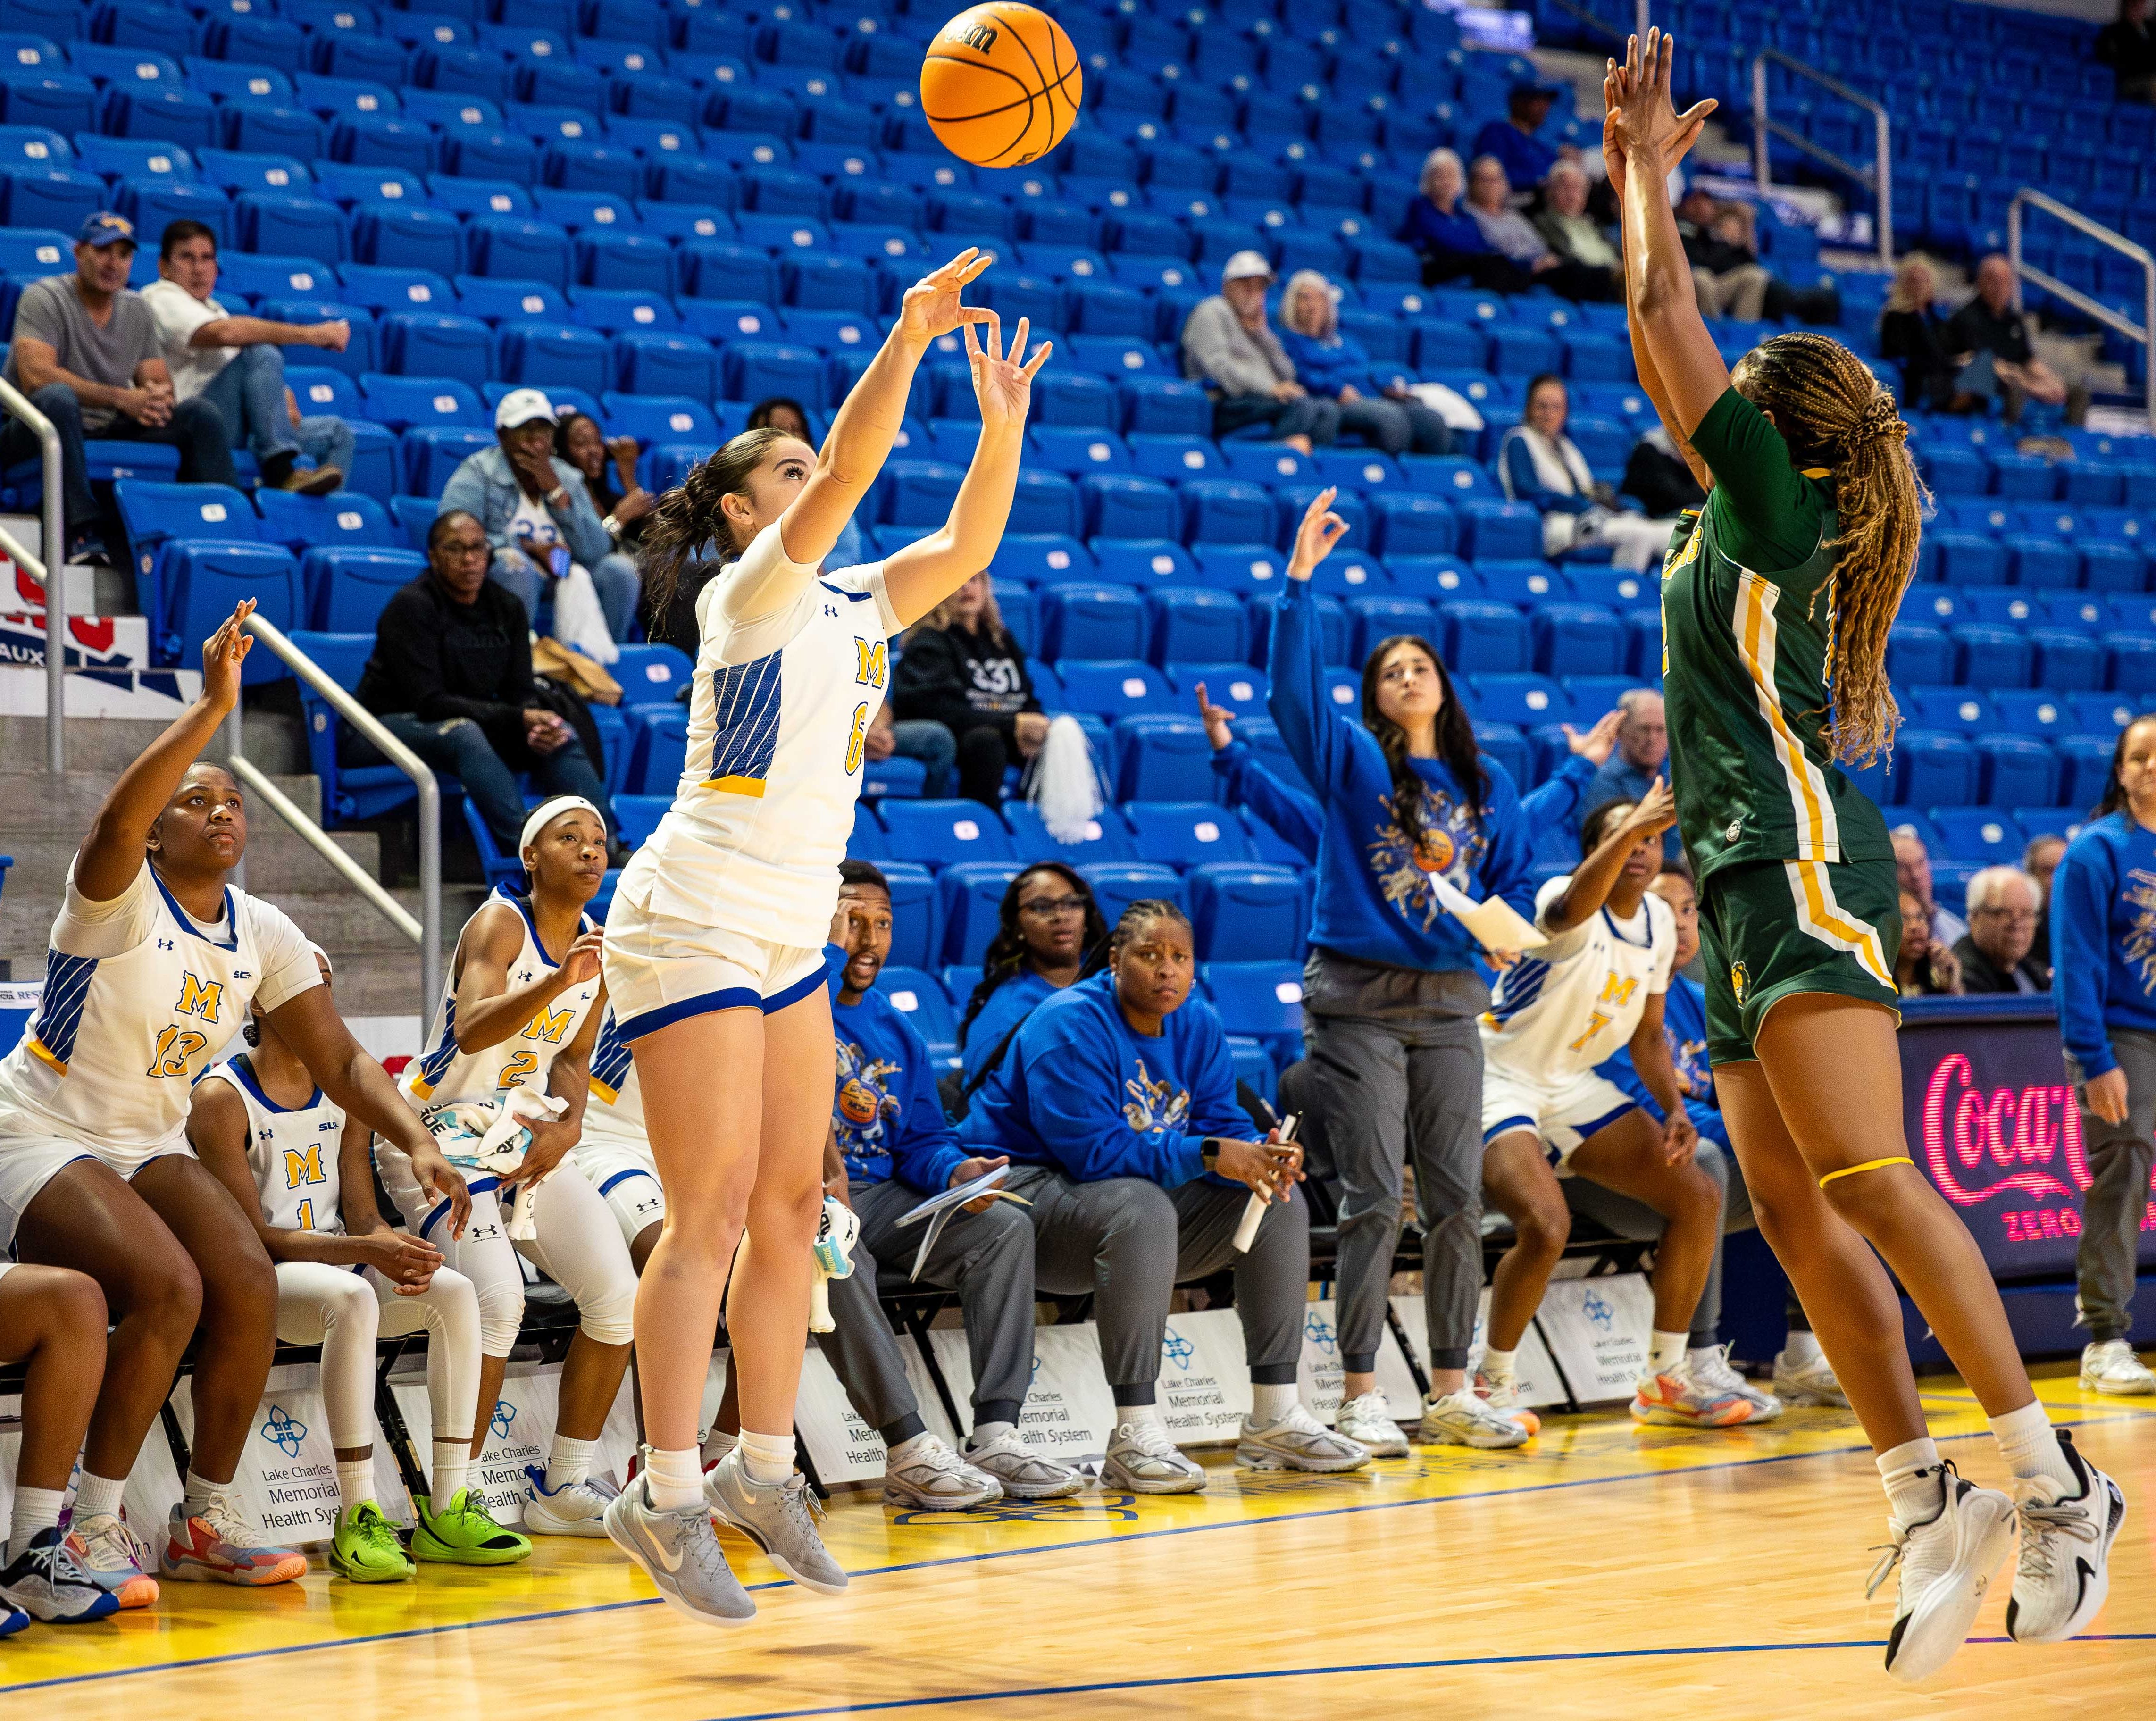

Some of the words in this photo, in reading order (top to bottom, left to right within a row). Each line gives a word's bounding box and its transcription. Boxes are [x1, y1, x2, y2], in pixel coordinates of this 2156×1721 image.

[854, 636, 886, 689] M
[845, 701, 868, 776] 6
[175, 970, 224, 1024] M
[1596, 968, 1639, 1008] M
[521, 1004, 576, 1044] M
[1569, 1009, 1614, 1053] 7
[146, 1024, 208, 1078] 13
[496, 1050, 538, 1091] 2
[283, 1143, 326, 1189] M
[297, 1198, 316, 1230] 1
[2001, 1207, 2082, 1241] ZERO
[1168, 1391, 1225, 1408] Memorial
[1048, 1429, 1093, 1445] System
[1163, 1414, 1203, 1429] Health
[481, 1451, 501, 1462] ake
[502, 1445, 541, 1459] Charles
[845, 1447, 886, 1464] Health
[262, 1469, 290, 1481] Lake
[291, 1464, 332, 1478] Charles
[268, 1481, 341, 1504] Memorial
[482, 1490, 522, 1508] ealth
[261, 1509, 312, 1529] Health
